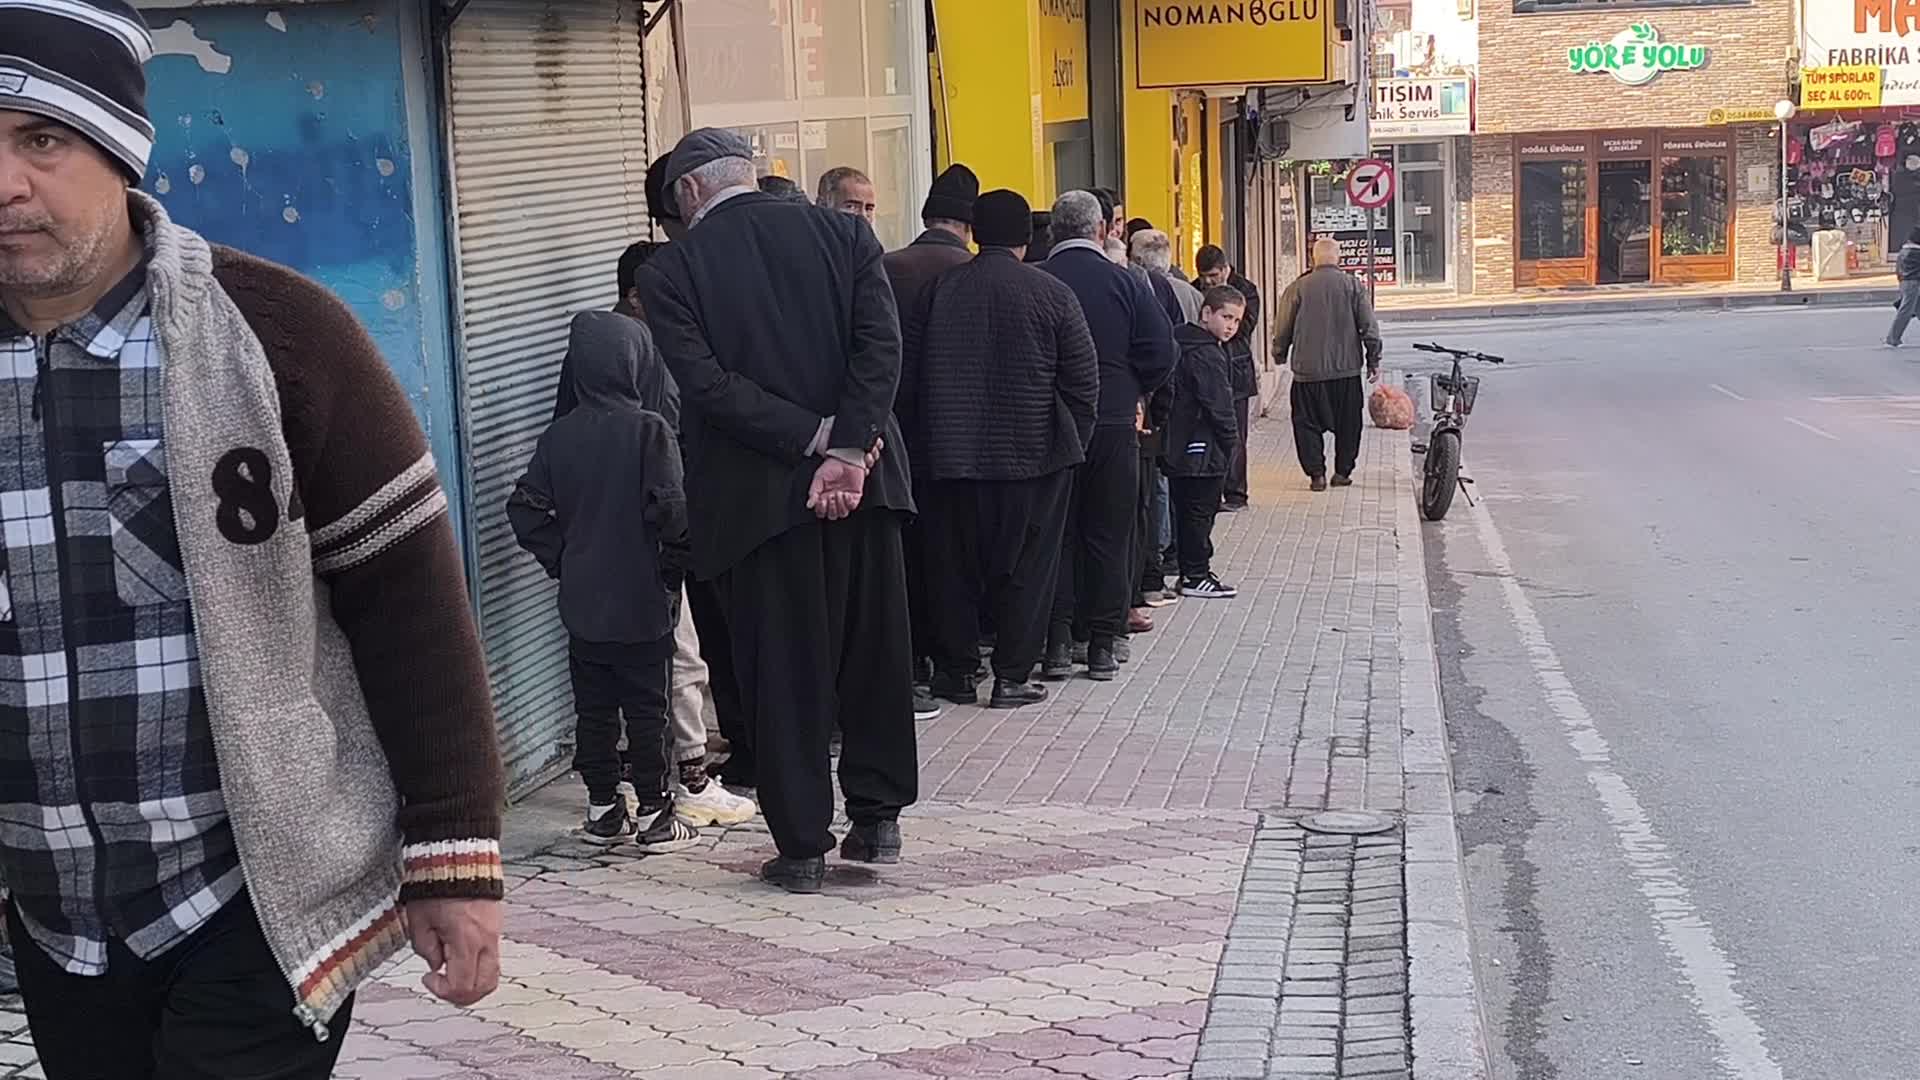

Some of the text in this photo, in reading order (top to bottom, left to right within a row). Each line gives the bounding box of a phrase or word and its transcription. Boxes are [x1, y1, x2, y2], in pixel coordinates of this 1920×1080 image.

[1569, 42, 1705, 70] YÖRE YOLU
[1828, 44, 1910, 66] FABRİKA
[1806, 71, 1875, 84] TÜM SPORLAR
[1369, 81, 1433, 105] TİŞİM
[1807, 90, 1826, 103] SEÇ
[1828, 90, 1842, 101] AL
[1399, 106, 1440, 119] Servis
[212, 447, 279, 545] 8
